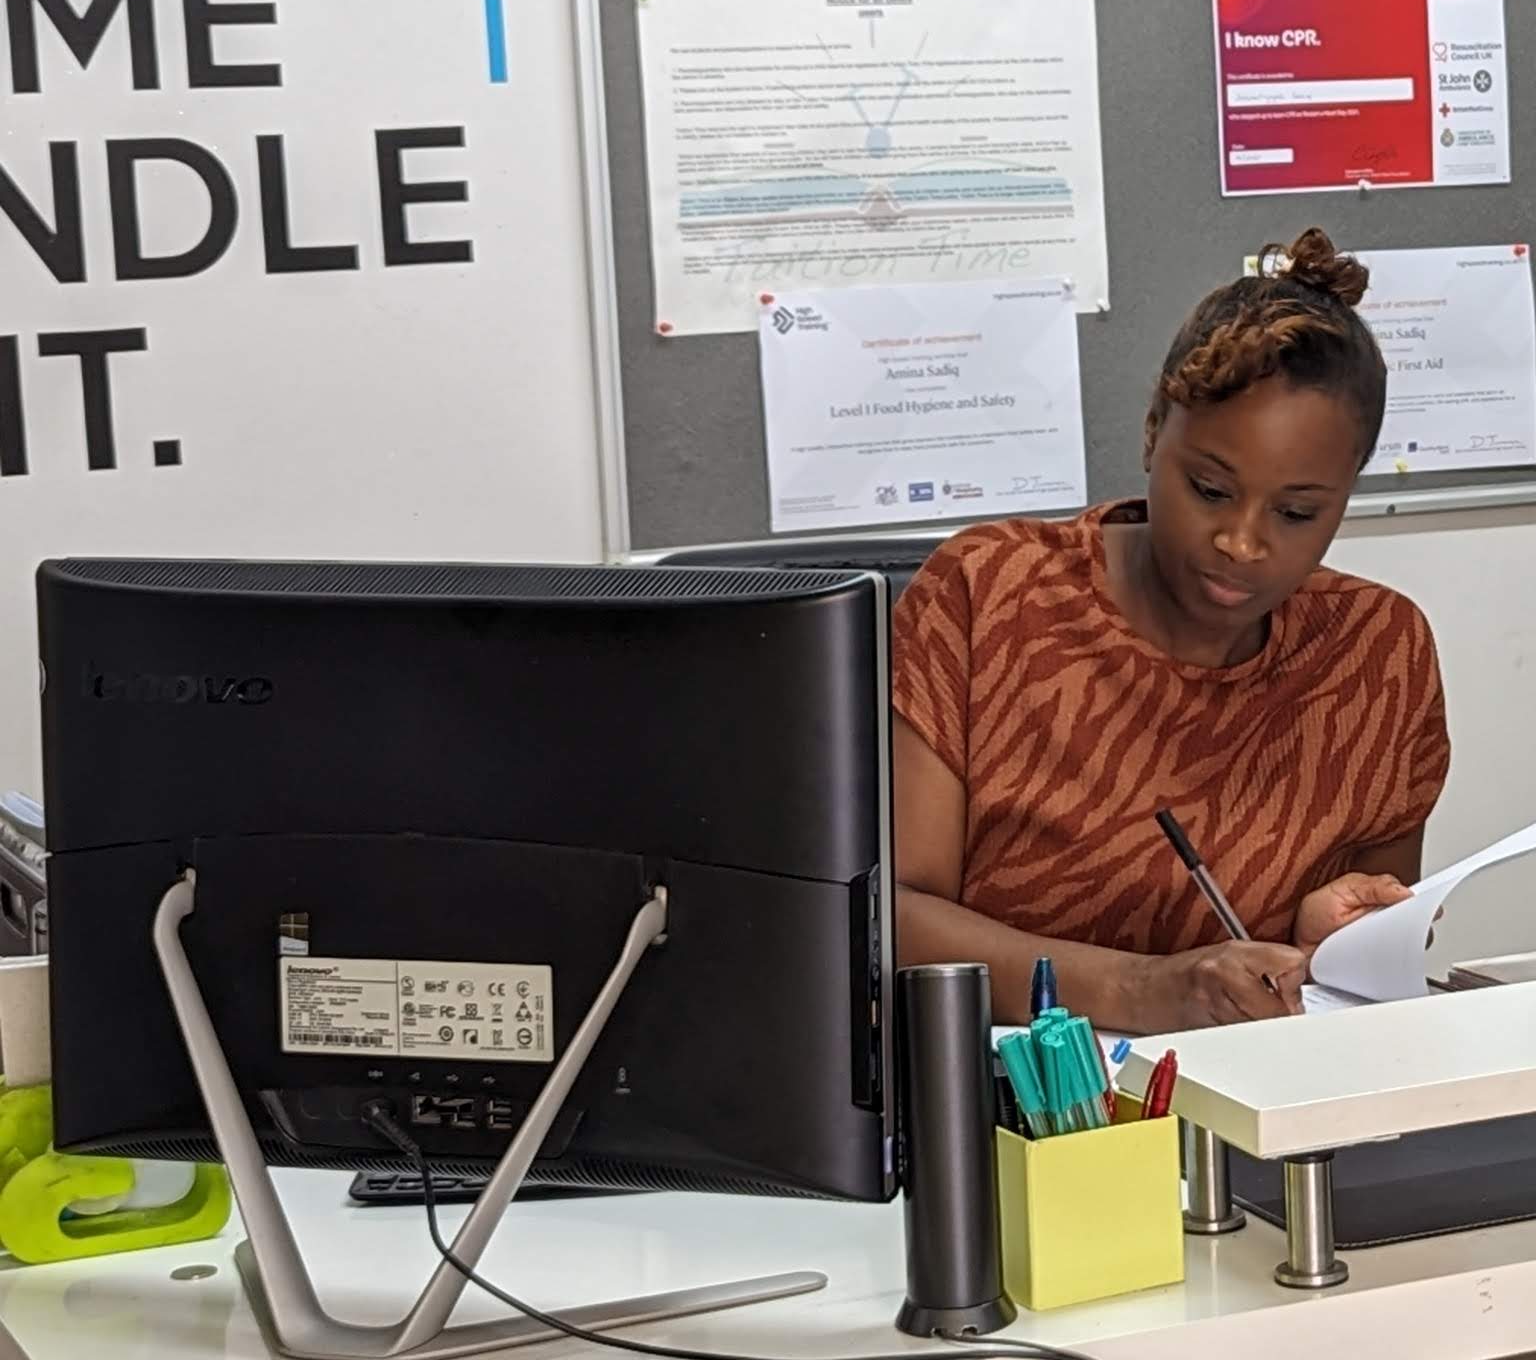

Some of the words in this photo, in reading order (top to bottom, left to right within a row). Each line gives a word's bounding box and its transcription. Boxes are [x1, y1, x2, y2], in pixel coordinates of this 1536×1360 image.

[1225, 31, 1231, 49] I
[1234, 31, 1279, 48] know
[1282, 29, 1322, 47] CPR.
[1451, 52, 1480, 61] Council
[1481, 52, 1494, 60] UK
[1438, 73, 1448, 86] St
[1449, 73, 1471, 85] John
[1397, 359, 1423, 372] First
[1425, 356, 1444, 370] Aid
[830, 403, 864, 418] Level
[873, 399, 904, 415] Food
[905, 396, 954, 415] Hygiene
[956, 395, 979, 409] and
[981, 394, 1016, 408] Safety
